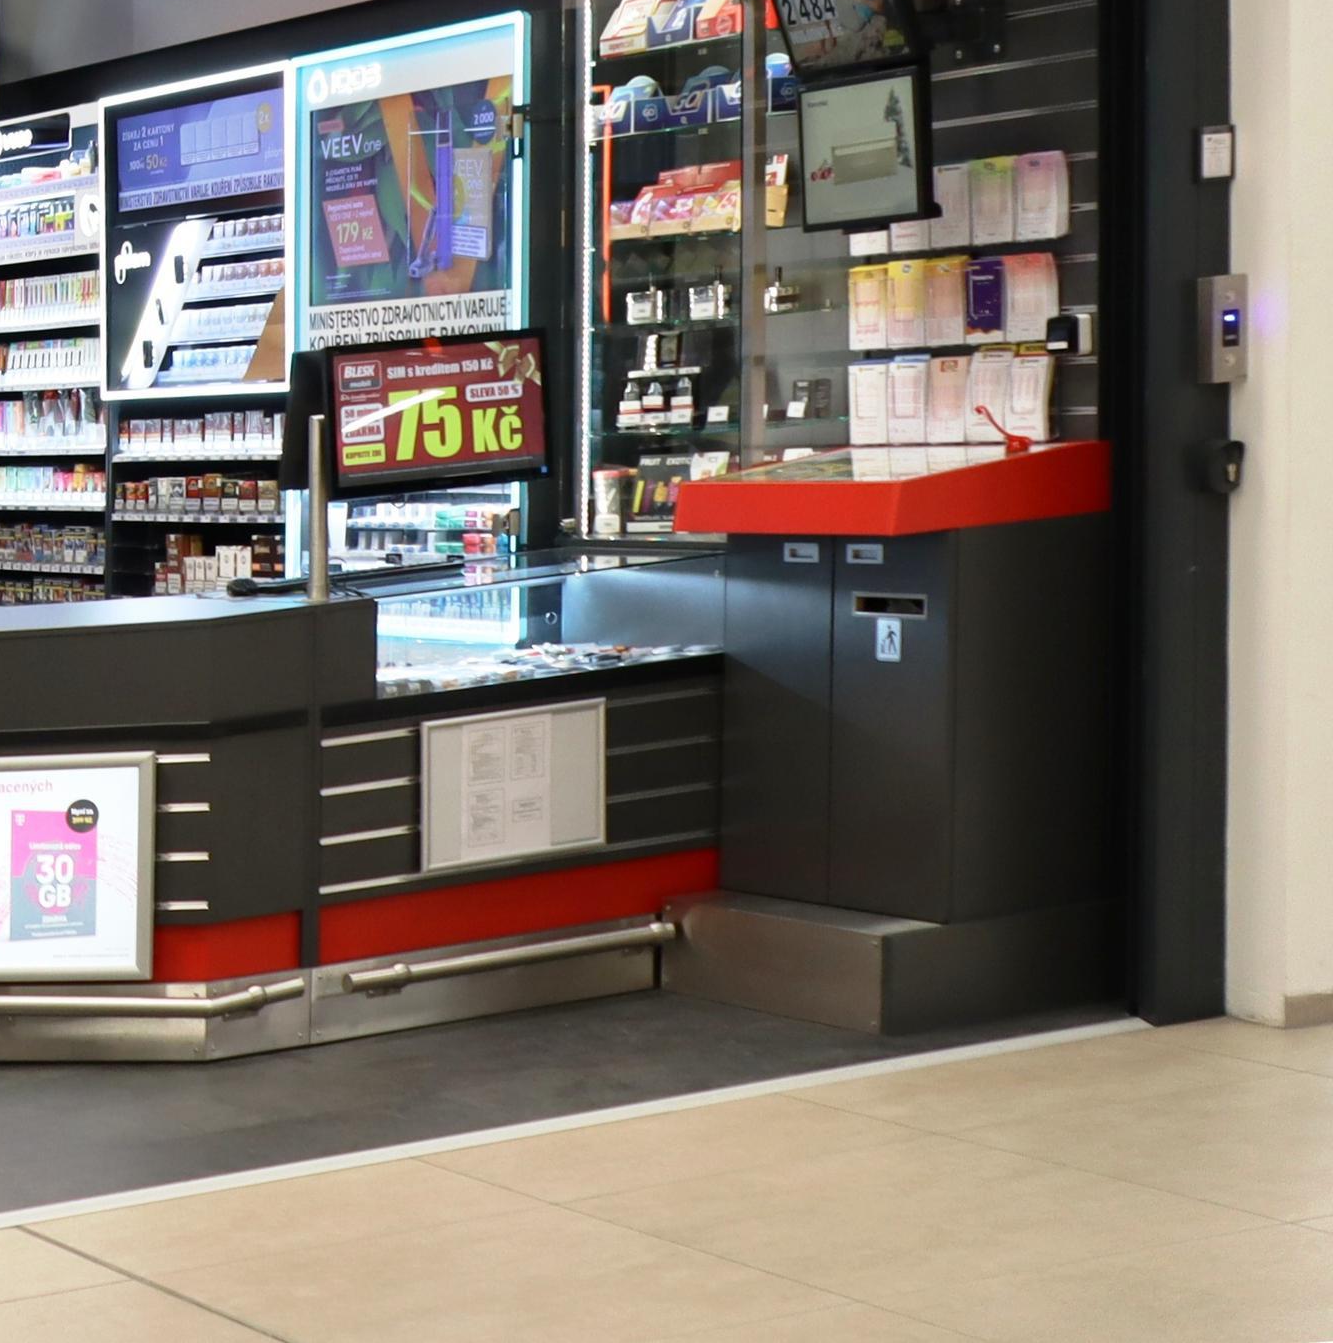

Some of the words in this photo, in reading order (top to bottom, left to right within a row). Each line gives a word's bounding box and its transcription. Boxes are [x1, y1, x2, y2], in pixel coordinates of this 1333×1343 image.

[321, 133, 364, 160] VEEV
[364, 139, 382, 153] one
[146, 156, 159, 170] 50
[336, 222, 360, 244] 179
[309, 306, 379, 331] MINISTERSTVO
[382, 296, 461, 325] ZDRAVOTNICTVÍ
[344, 364, 375, 379] BLESK
[387, 366, 406, 379] SIM
[407, 369, 413, 378] s
[415, 362, 460, 377] kreditem
[461, 360, 479, 372] 150
[480, 358, 494, 371] Kč
[470, 385, 495, 398] SLEVA
[497, 384, 510, 396] 50
[388, 386, 463, 461] 75
[472, 406, 523, 453] Kč
[36, 854, 74, 885] 30
[38, 884, 71, 908] GB
